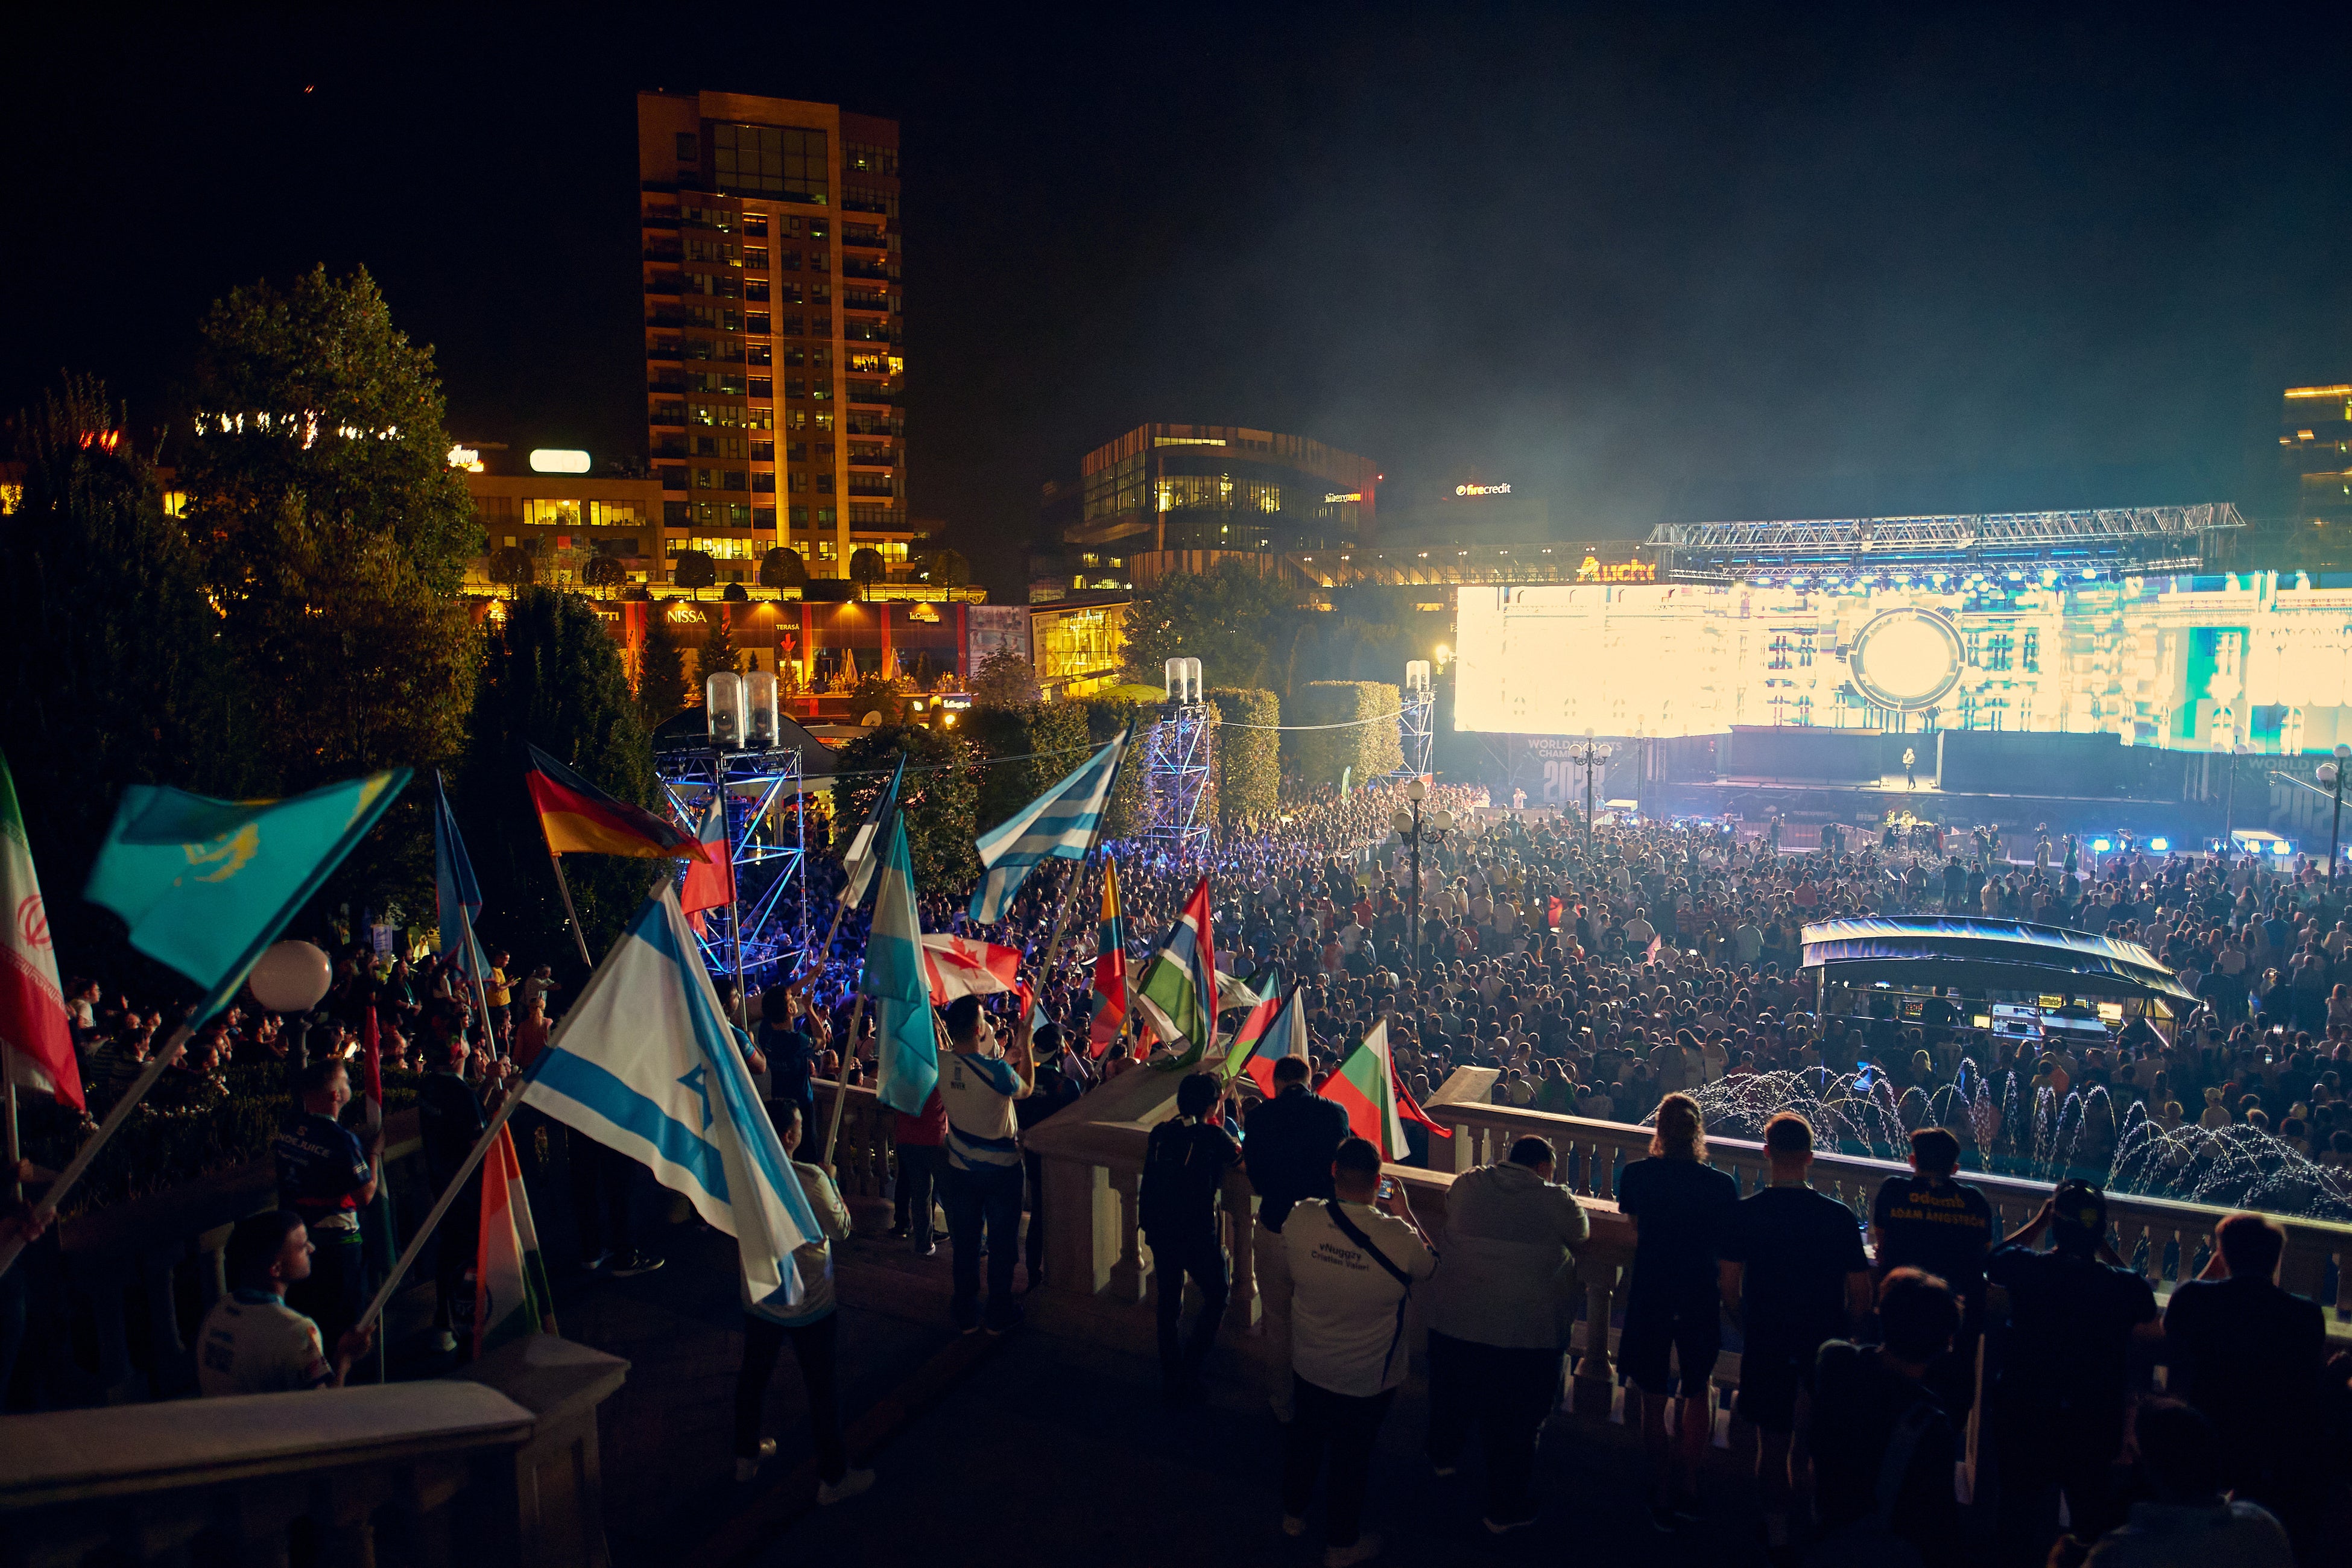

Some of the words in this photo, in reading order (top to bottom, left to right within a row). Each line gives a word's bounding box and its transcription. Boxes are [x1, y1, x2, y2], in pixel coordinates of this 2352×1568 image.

[1466, 482, 1511, 496] firecredit
[667, 610, 707, 623] NISSA
[1528, 739, 1570, 750] WORLD
[2248, 758, 2309, 771] WORLD
[1544, 760, 1605, 803] 2023
[1890, 1207, 1923, 1219] ADAM
